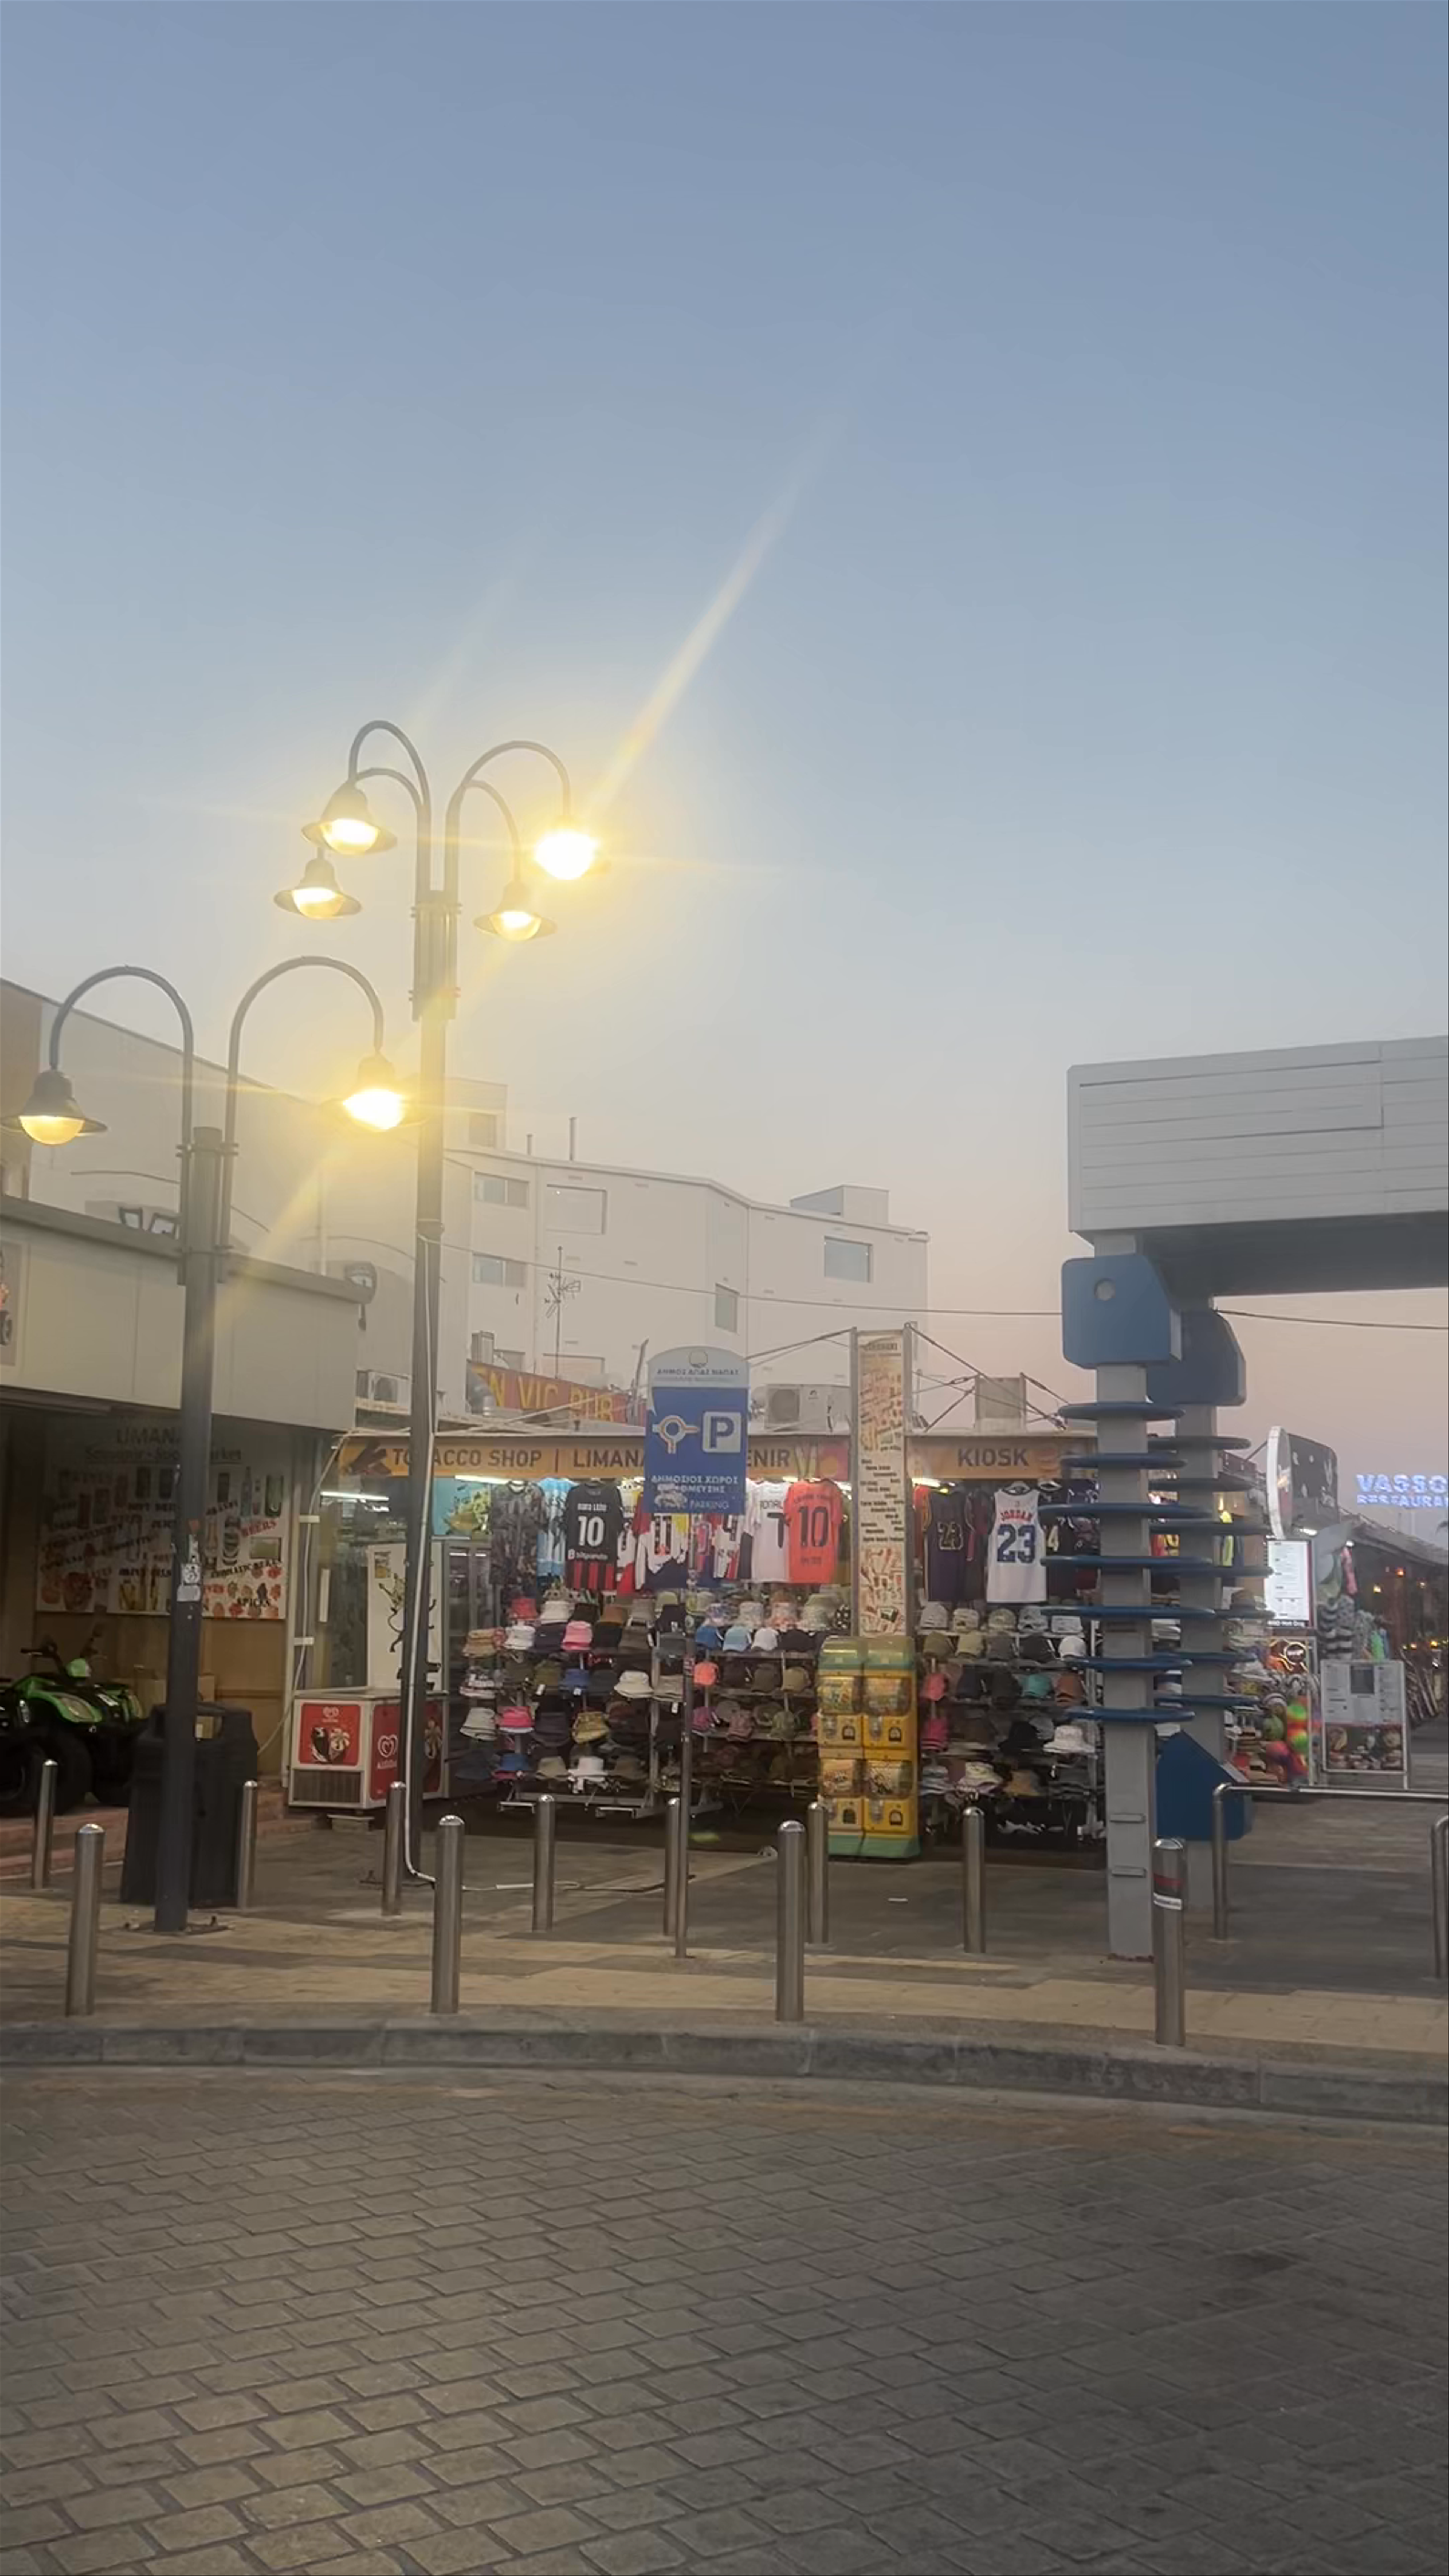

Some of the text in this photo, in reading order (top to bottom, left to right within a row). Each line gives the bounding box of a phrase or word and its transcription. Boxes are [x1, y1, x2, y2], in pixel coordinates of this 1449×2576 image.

[710, 1416, 734, 1449] P
[392, 1448, 481, 1466] TACCO
[488, 1449, 542, 1467] SHOP
[573, 1449, 645, 1468] LIMAN
[958, 1448, 1029, 1467] KIOSK
[578, 1516, 604, 1547] 10
[798, 1506, 829, 1547] 10
[997, 1524, 1036, 1563] 23
